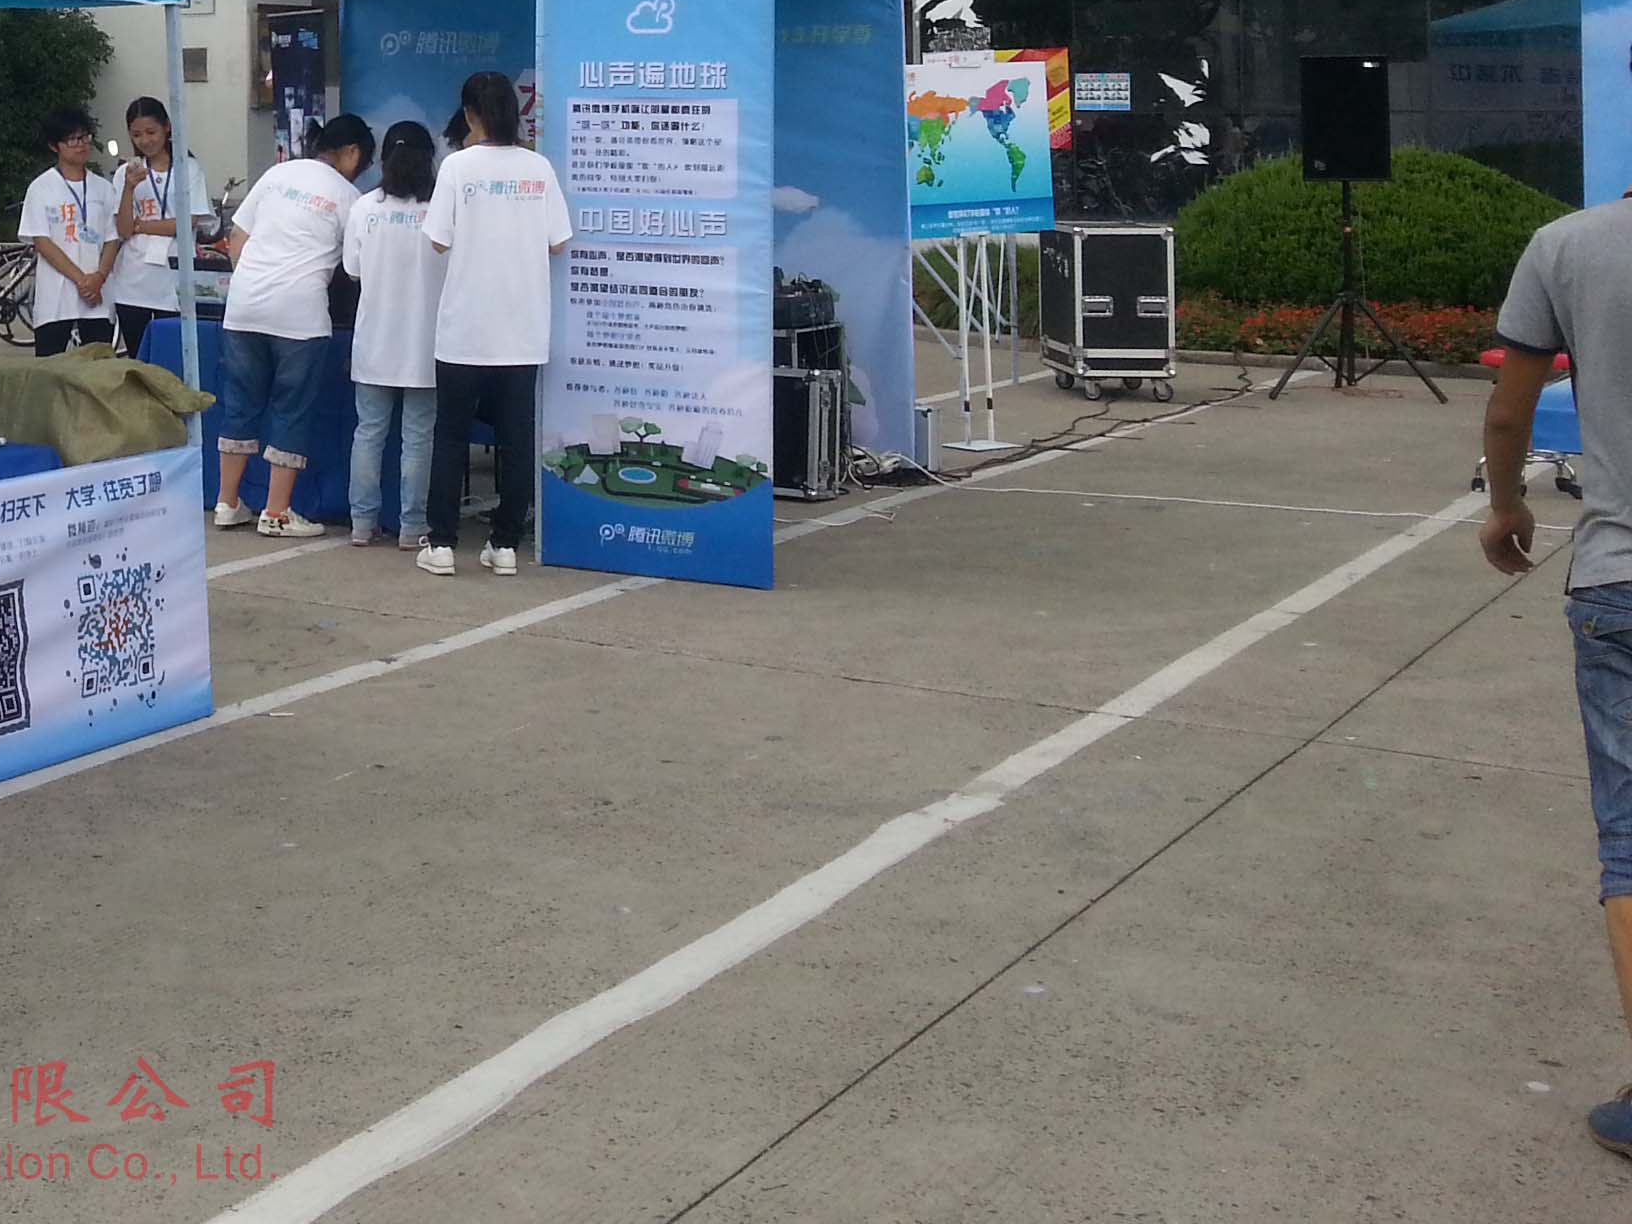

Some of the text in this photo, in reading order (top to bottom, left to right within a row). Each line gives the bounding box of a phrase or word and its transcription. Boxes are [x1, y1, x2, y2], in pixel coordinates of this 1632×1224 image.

[578, 61, 728, 90] 心声遍地球
[579, 208, 727, 238] 中国好心声
